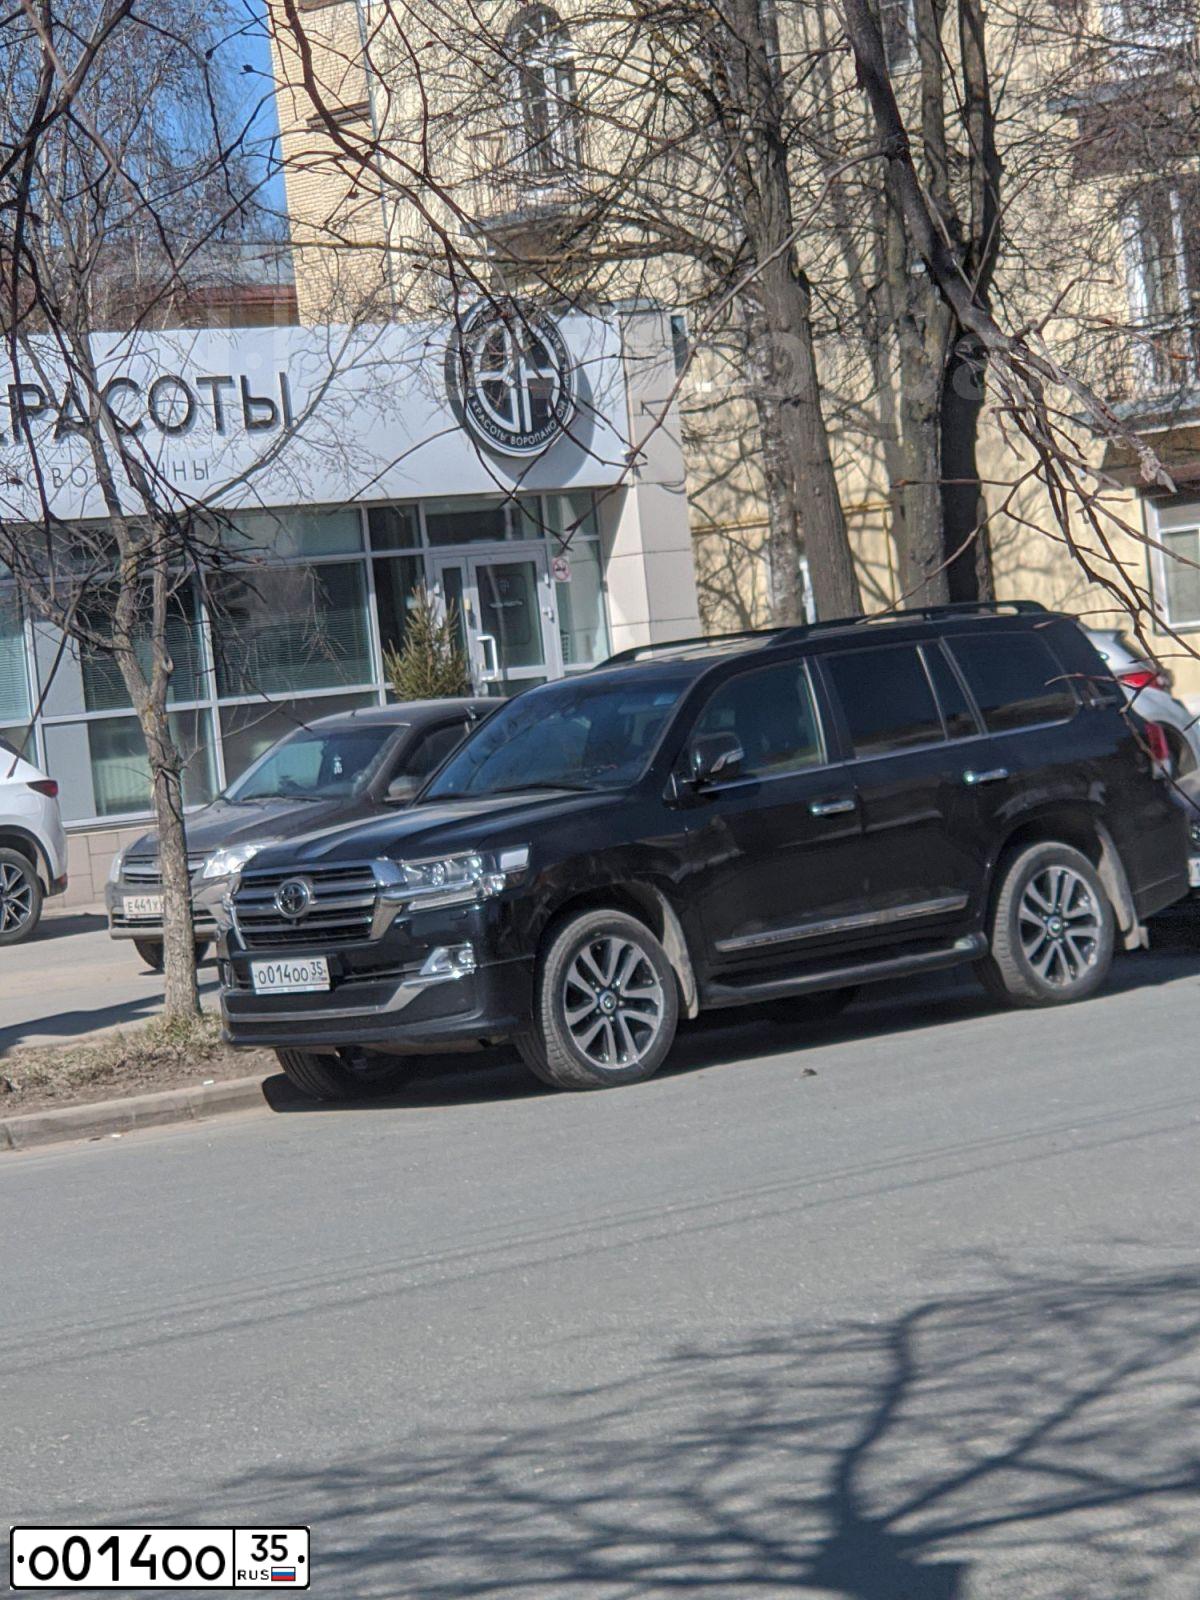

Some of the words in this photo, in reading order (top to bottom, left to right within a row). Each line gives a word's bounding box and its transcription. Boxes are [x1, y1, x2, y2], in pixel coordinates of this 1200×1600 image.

[0, 371, 292, 446] РАСОТЫ
[259, 964, 309, 984] О014ОО
[310, 961, 323, 976] 35
